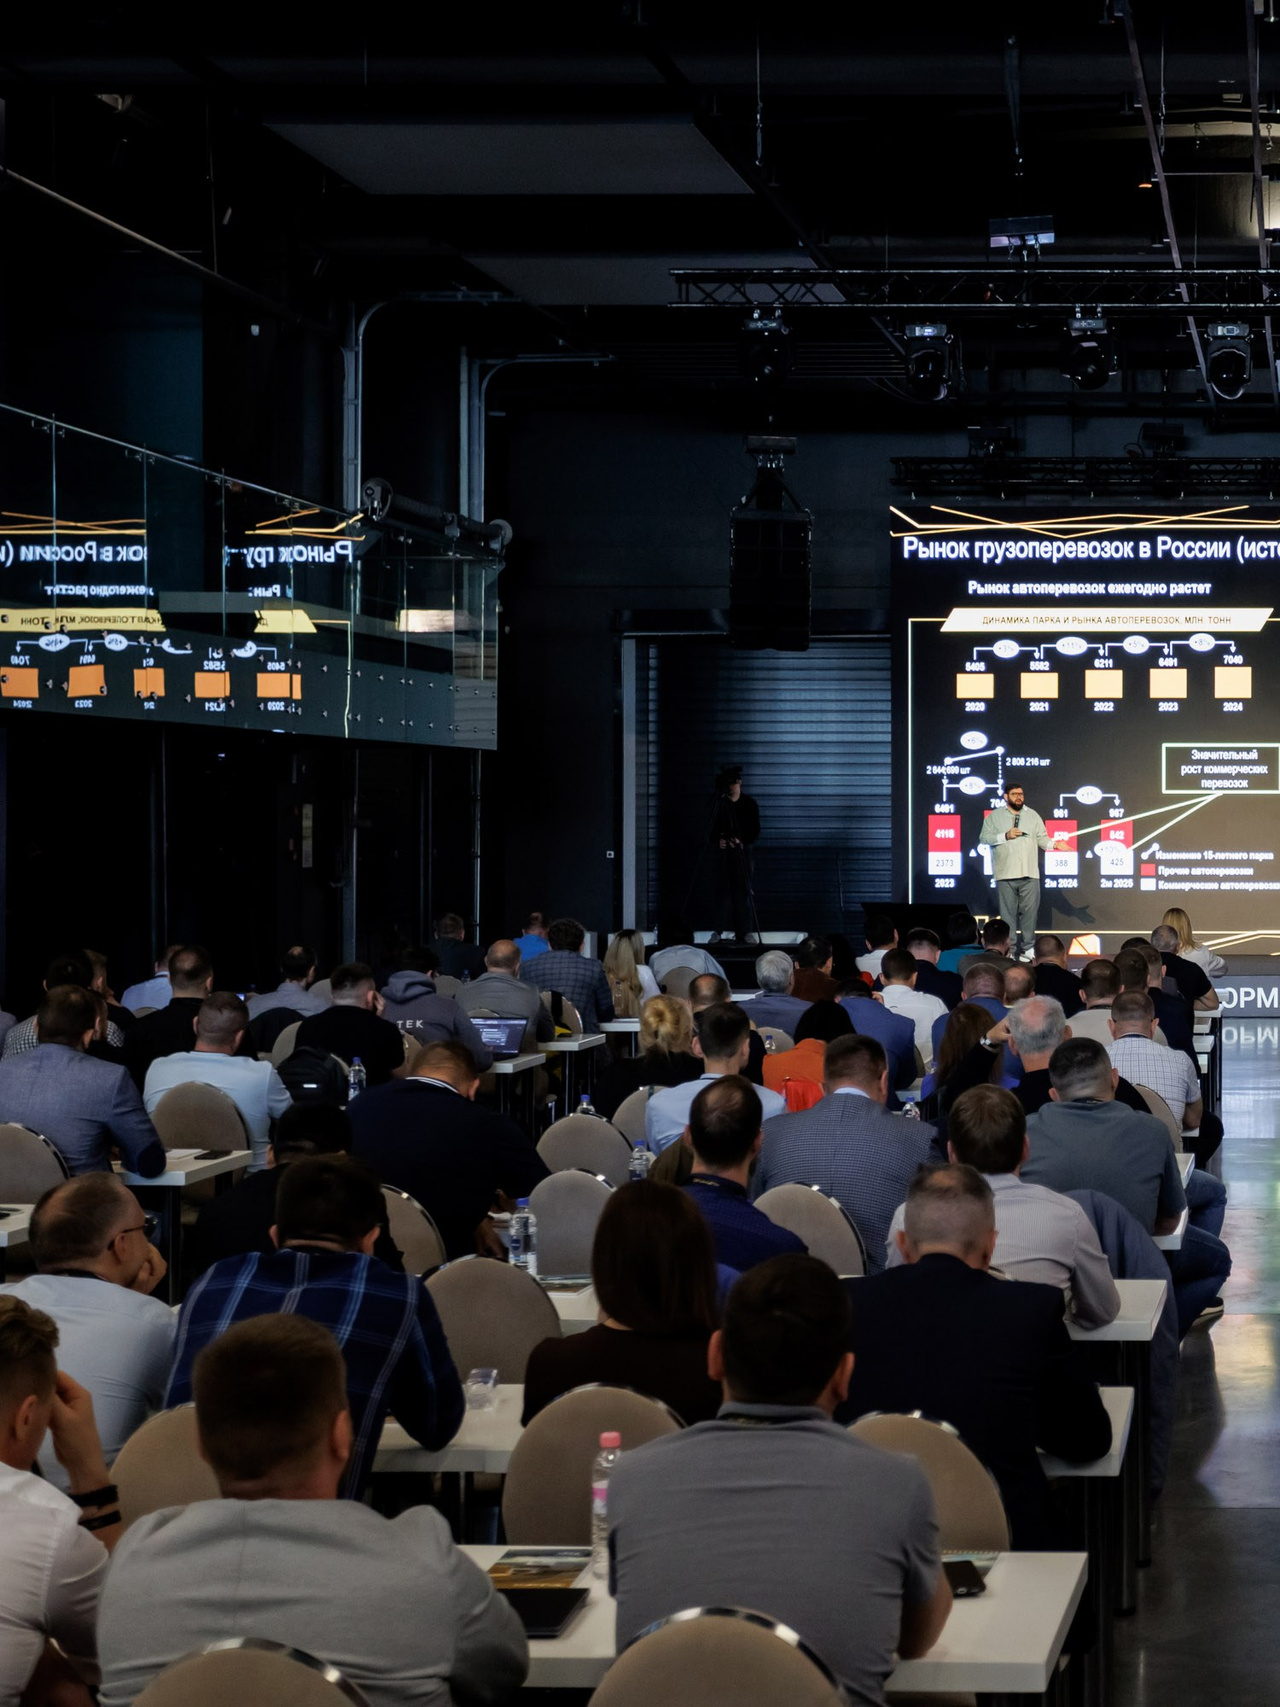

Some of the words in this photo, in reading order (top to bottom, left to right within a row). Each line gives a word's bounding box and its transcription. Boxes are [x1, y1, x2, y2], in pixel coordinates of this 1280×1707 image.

[903, 536, 969, 558] Рынок
[974, 541, 1133, 562] грузоперевозок
[1139, 541, 1150, 558] в
[1157, 536, 1231, 558] России
[968, 580, 1010, 594] Рынок
[1012, 583, 1105, 596] автоперевозок
[1108, 583, 1167, 596] ежегодно
[1169, 583, 1211, 596] растет
[982, 615, 1030, 625] ДИНАМИКА
[1032, 615, 1061, 624] ПАРКА
[1063, 615, 1070, 624] И
[1072, 615, 1103, 624] РЫНКА
[1208, 616, 1232, 624] ТОНН
[1223, 655, 1243, 664] 7040
[965, 702, 985, 712] 2020
[1030, 702, 1049, 712] 2021
[1094, 702, 1114, 712] 2022
[1159, 702, 1178, 712] 2023
[1223, 702, 1243, 712] 2024
[1191, 749, 1258, 760] Значительный
[1181, 765, 1202, 776] рост
[1204, 766, 1268, 776] коммерческих
[1201, 780, 1248, 790] перевозок
[1155, 851, 1202, 860] Изменение
[1249, 852, 1274, 862] парка
[936, 859, 954, 867] 2373
[1055, 859, 1068, 867] 388
[1110, 858, 1124, 866] 425
[1158, 866, 1189, 876] Прочие
[1191, 867, 1253, 877] автоперевозки
[935, 879, 955, 888] 2023
[1058, 879, 1078, 888] 2024
[1113, 879, 1134, 888] 2025
[1158, 881, 1219, 891] Коммерческие
